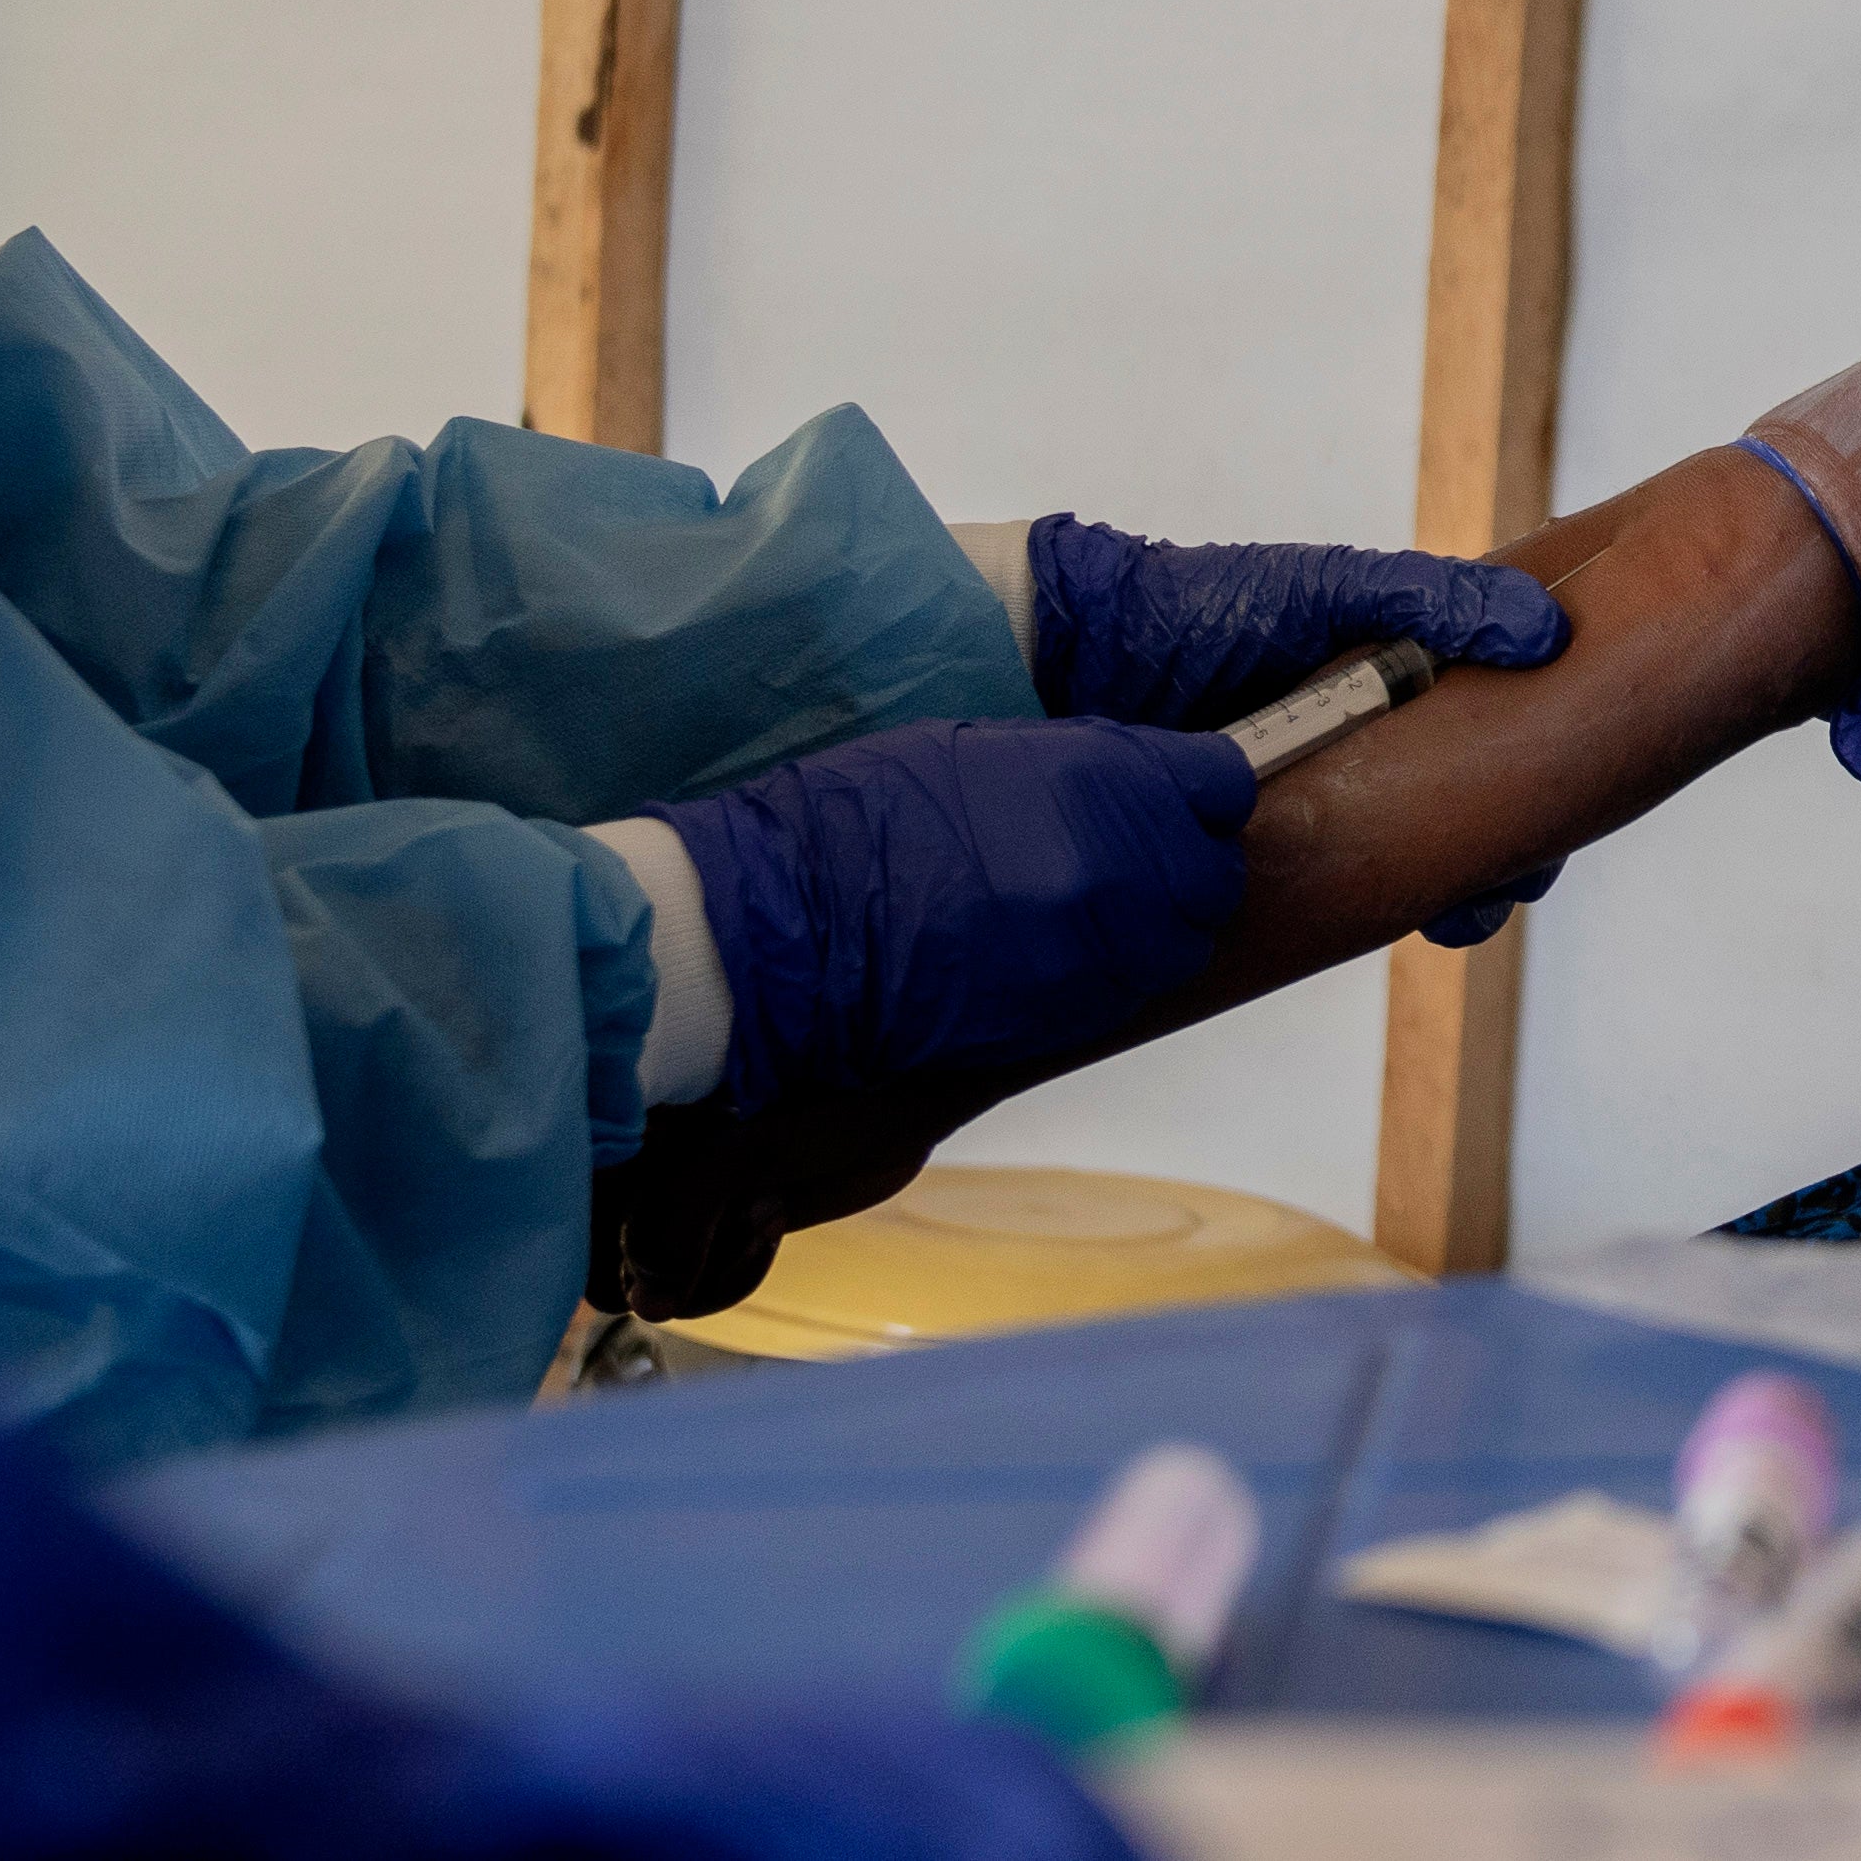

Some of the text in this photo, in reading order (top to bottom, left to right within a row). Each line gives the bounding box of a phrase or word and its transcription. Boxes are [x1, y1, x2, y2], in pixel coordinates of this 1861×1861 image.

[1348, 679, 1364, 691] 2
[1317, 696, 1331, 707] 3
[1254, 729, 1269, 740] 5
